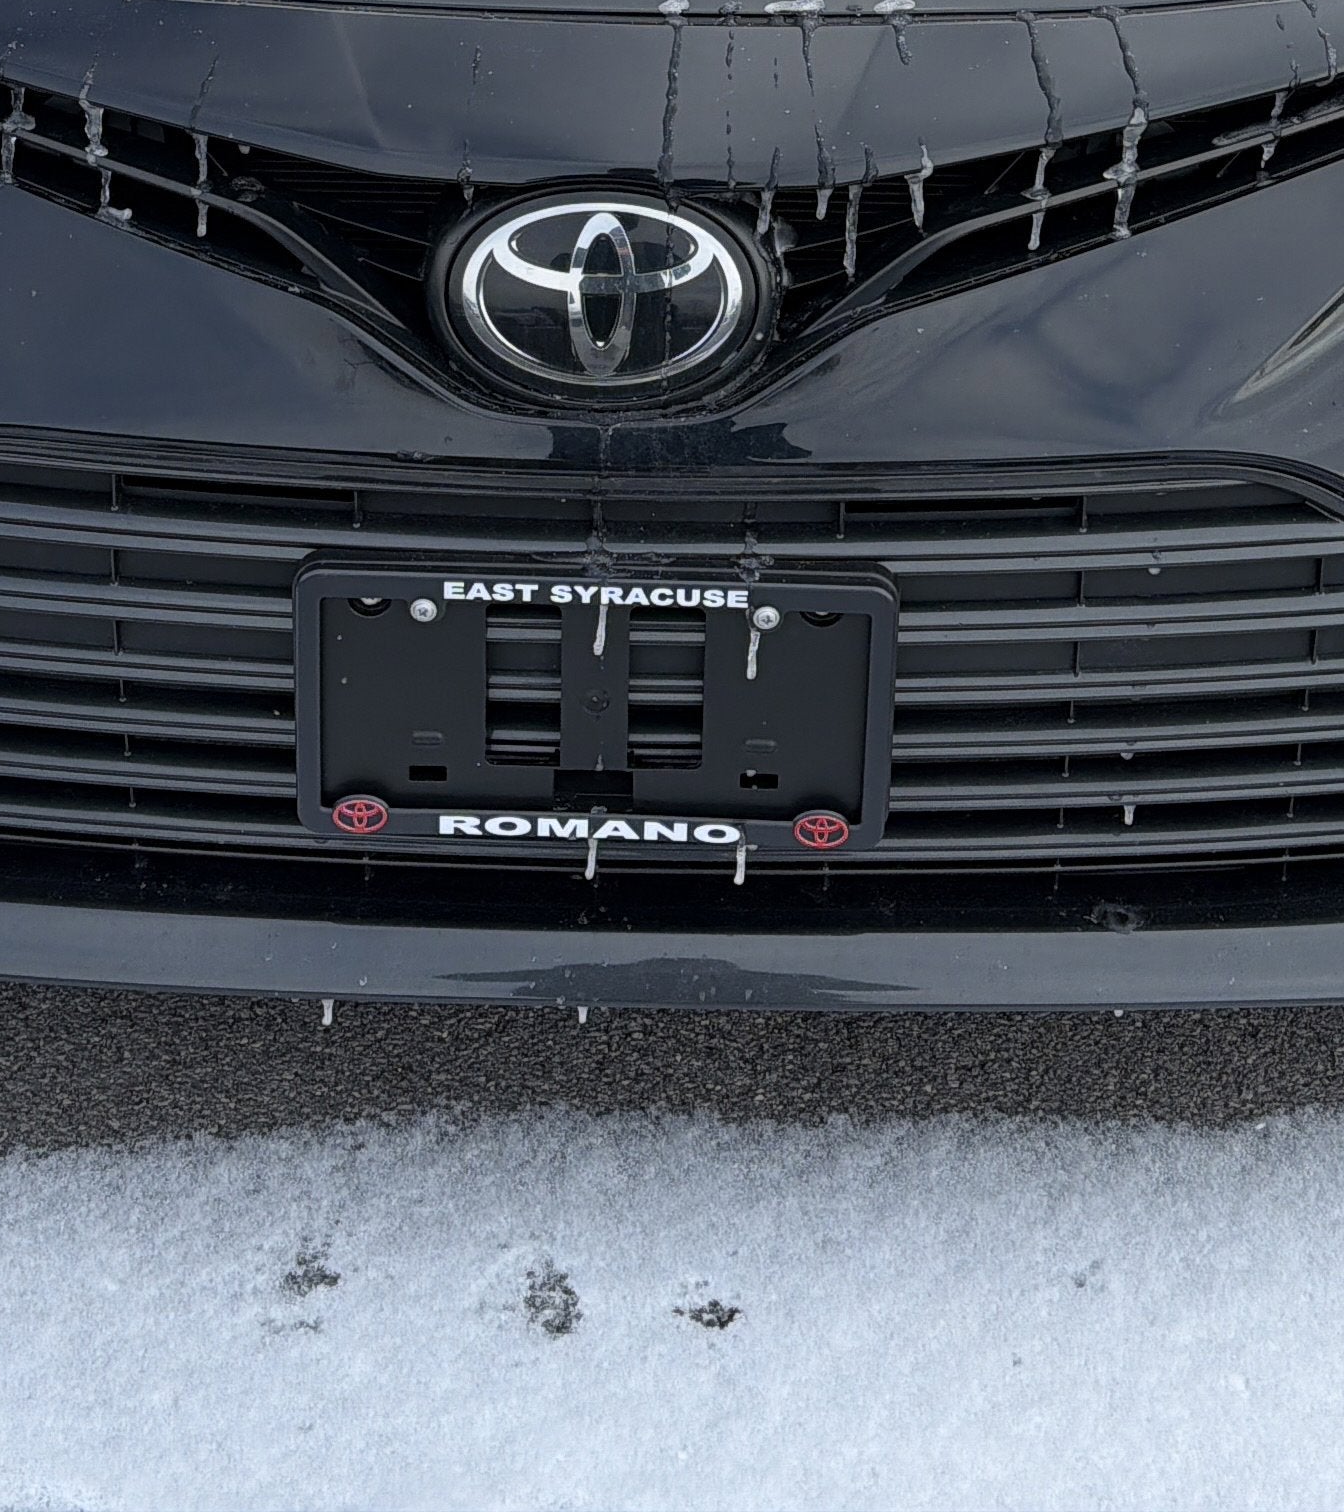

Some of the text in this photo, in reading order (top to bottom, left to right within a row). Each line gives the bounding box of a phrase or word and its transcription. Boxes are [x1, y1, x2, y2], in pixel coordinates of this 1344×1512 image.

[443, 581, 749, 609] EAST SYRACUSE
[438, 815, 741, 844] ROMANO
